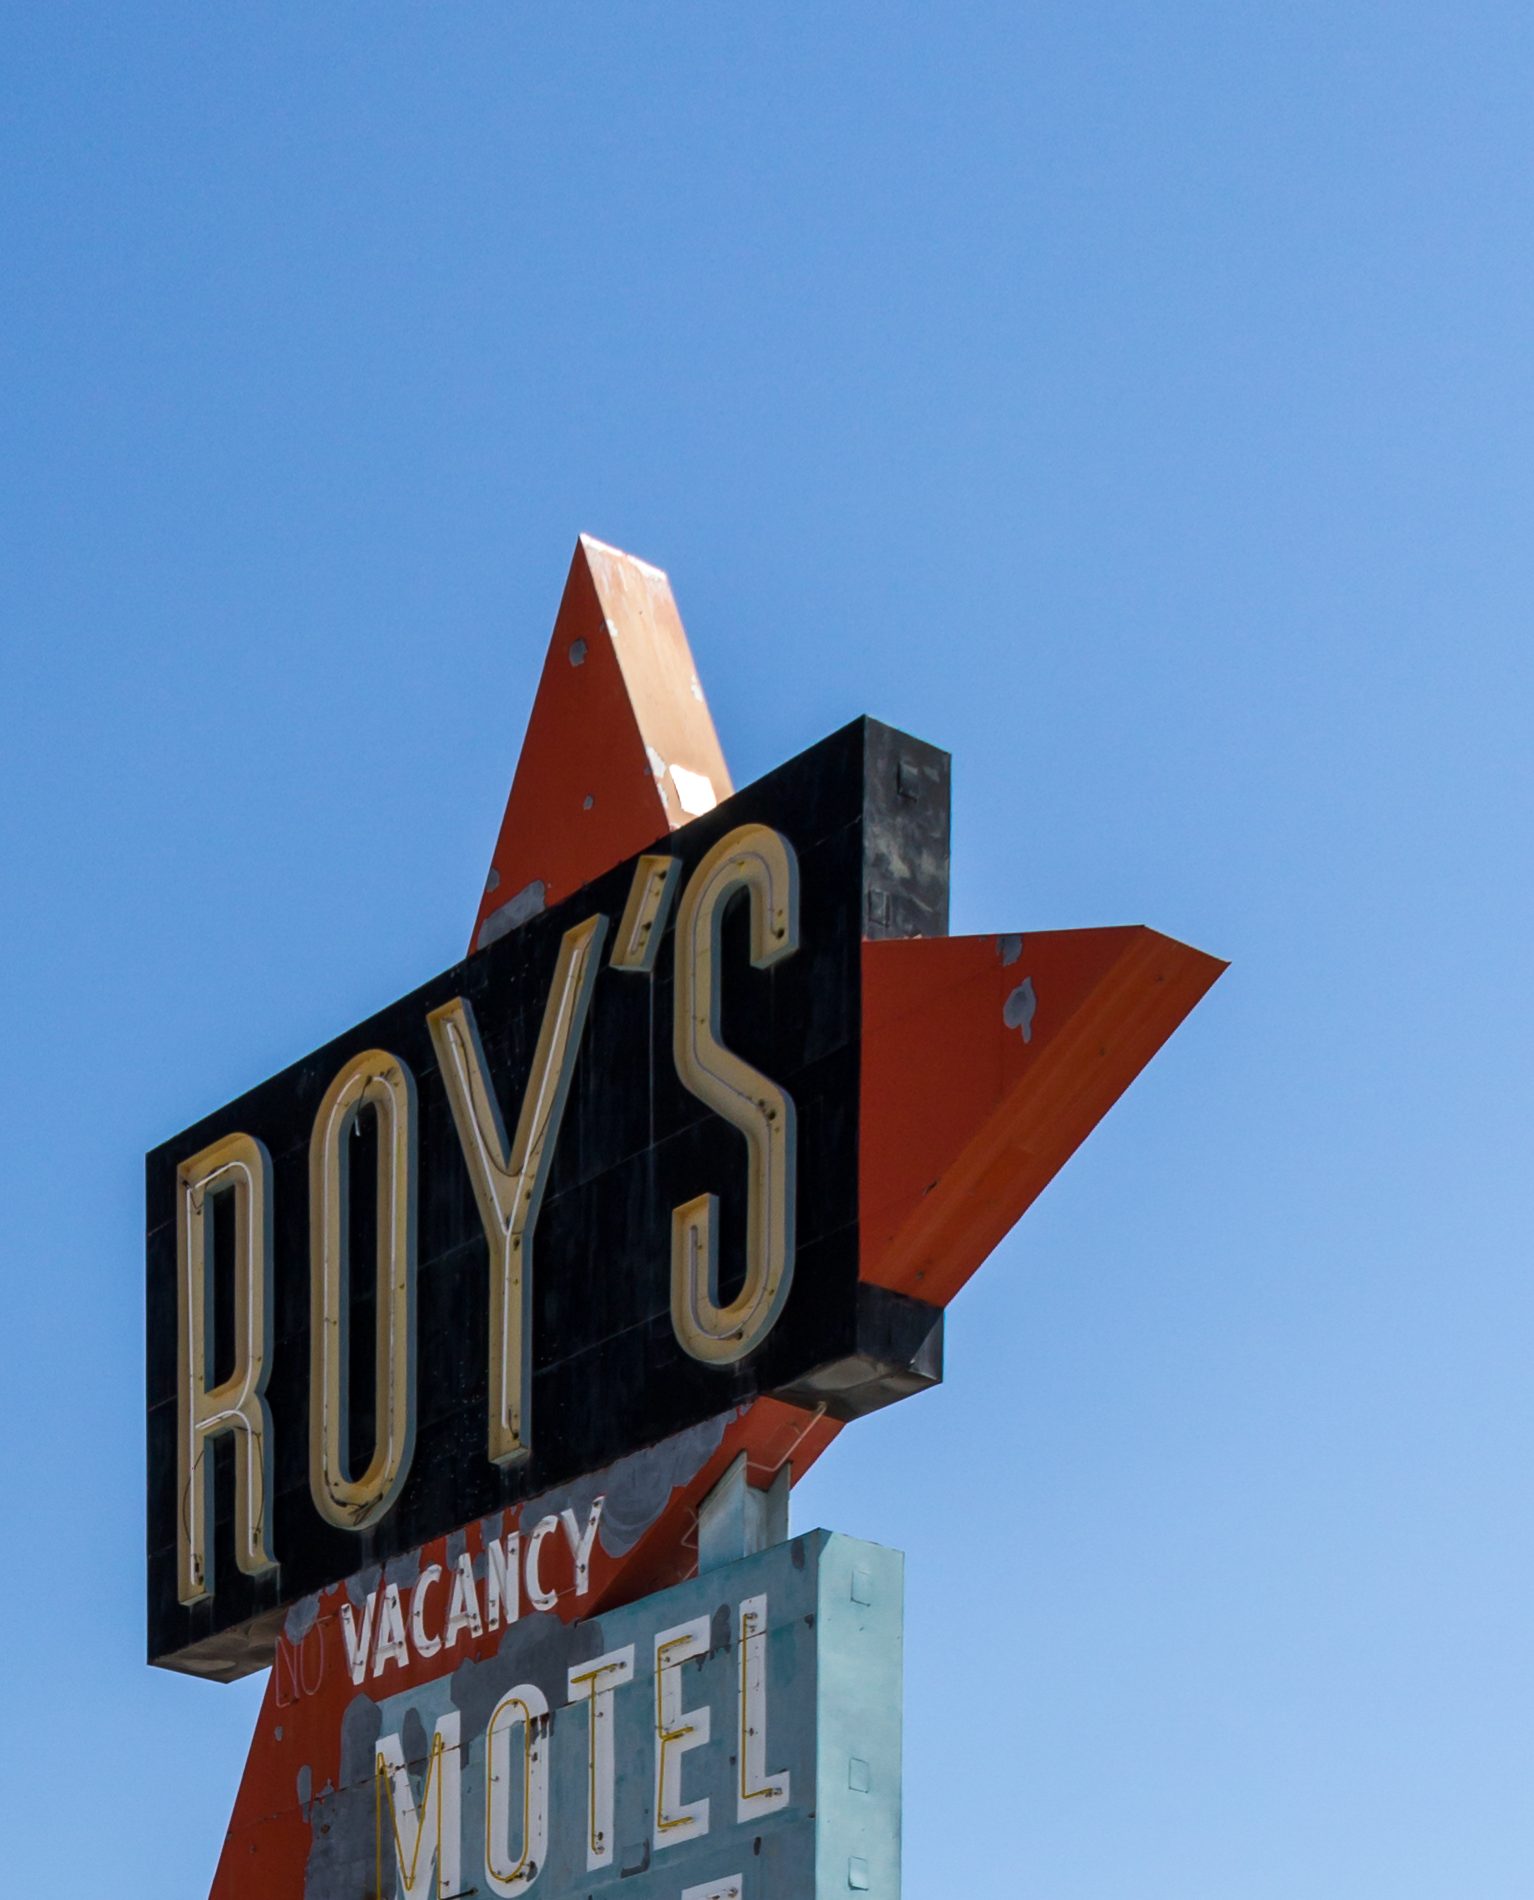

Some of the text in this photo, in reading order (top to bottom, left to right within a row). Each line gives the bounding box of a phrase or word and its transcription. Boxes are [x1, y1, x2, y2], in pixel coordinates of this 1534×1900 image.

[177, 823, 799, 1606] ROY'S
[275, 1493, 606, 1708] NO VACANCY
